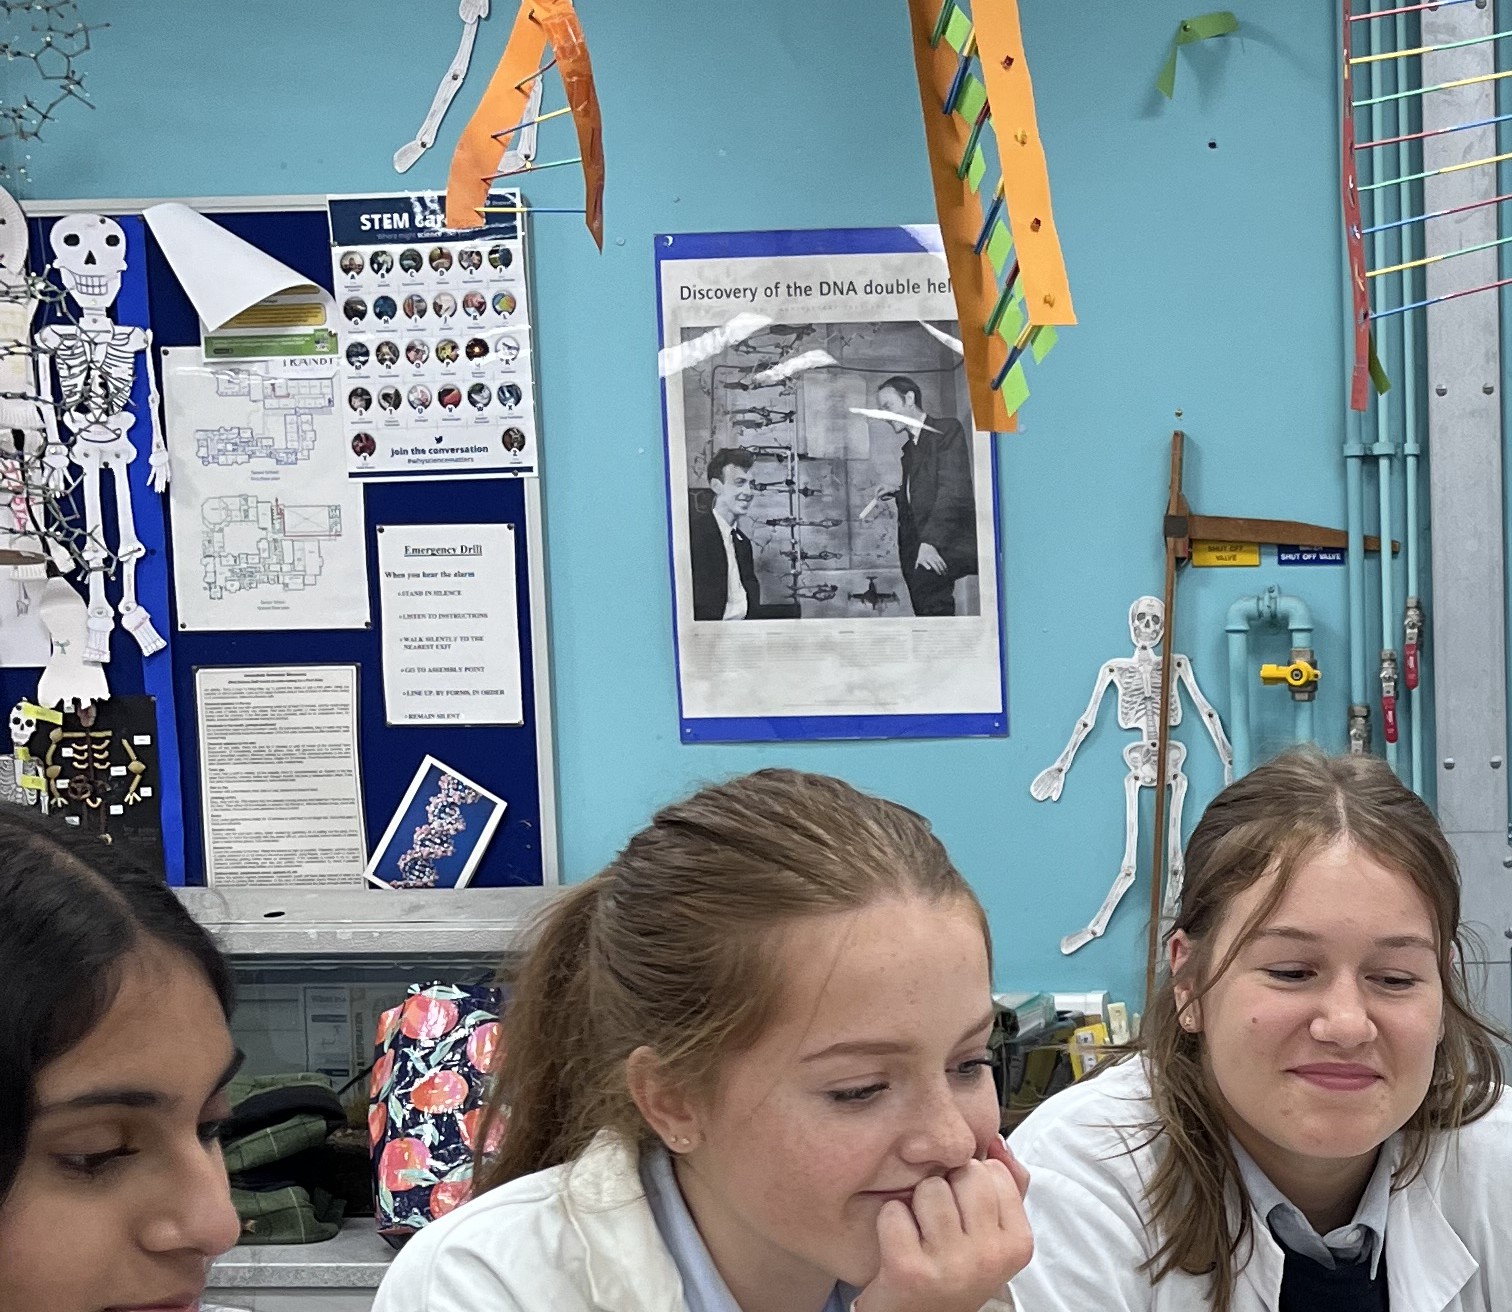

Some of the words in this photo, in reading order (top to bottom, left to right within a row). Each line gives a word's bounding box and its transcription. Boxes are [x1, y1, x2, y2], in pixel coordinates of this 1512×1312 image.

[360, 213, 409, 230] STEM
[680, 285, 757, 303] Discovery
[764, 282, 780, 297] of
[786, 282, 812, 297] the
[820, 281, 857, 296] DNA
[864, 279, 920, 294] double
[927, 278, 951, 293] hel
[391, 448, 409, 457] join
[411, 446, 426, 455] the
[428, 446, 488, 455] conversation
[404, 545, 456, 555] Emergency
[461, 545, 482, 554] Drill
